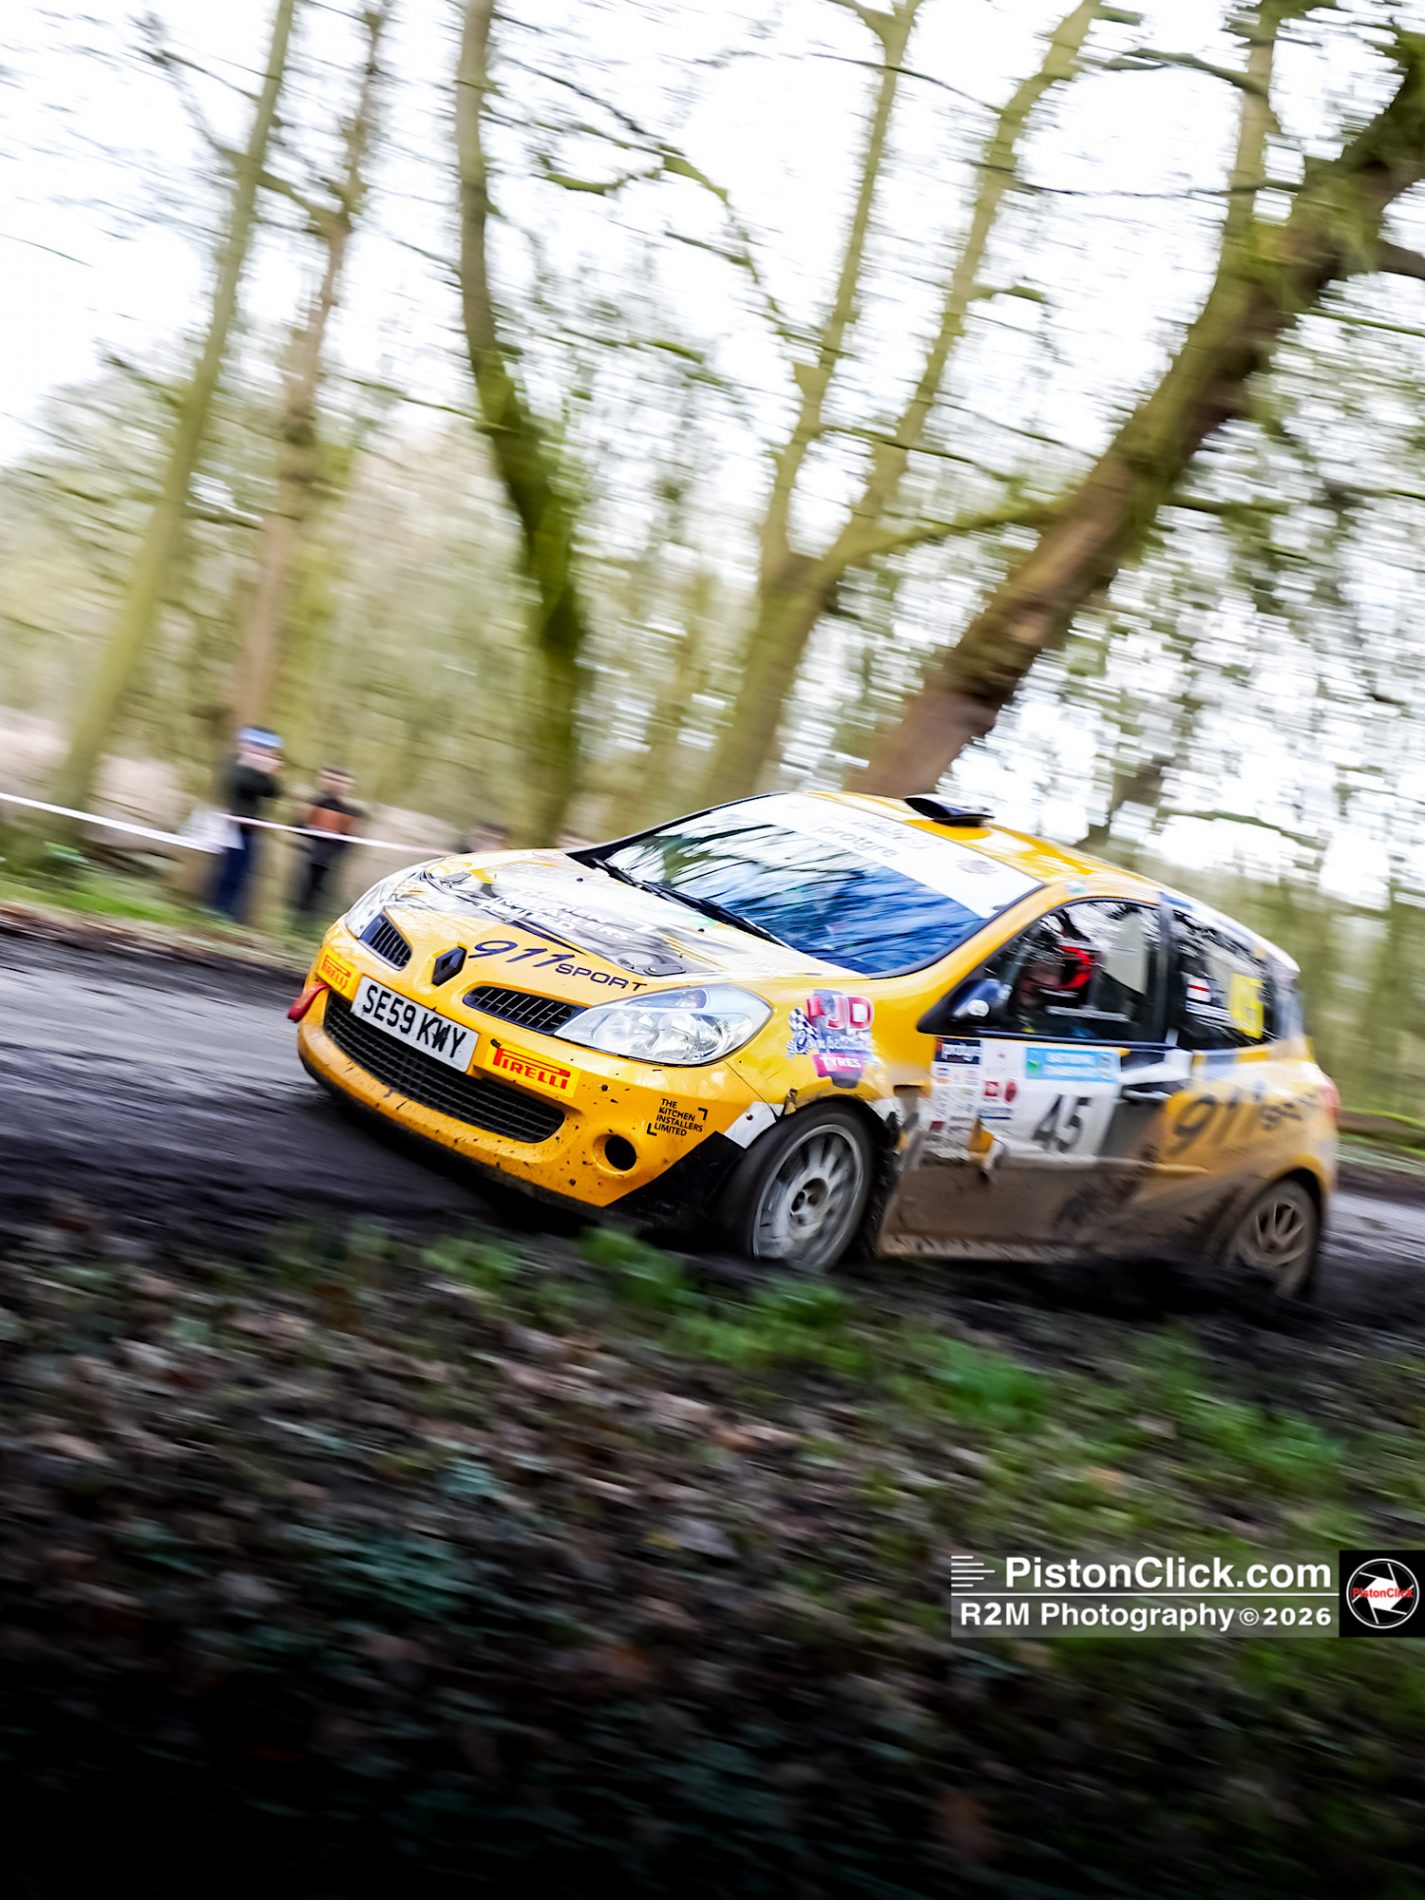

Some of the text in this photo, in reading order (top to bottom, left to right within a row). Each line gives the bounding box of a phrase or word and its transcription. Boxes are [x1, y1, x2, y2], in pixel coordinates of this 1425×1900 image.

[469, 940, 647, 991] 911 SPORT
[362, 984, 467, 1059] SE59 KWY
[493, 1048, 571, 1090] PIRELLI
[819, 1056, 863, 1069] TYRES
[661, 1098, 678, 1109] THE
[656, 1114, 704, 1132] INSTALLERS
[659, 1106, 696, 1122] KITCHEN
[654, 1122, 687, 1136] LIMITED
[1031, 1094, 1092, 1154] 45
